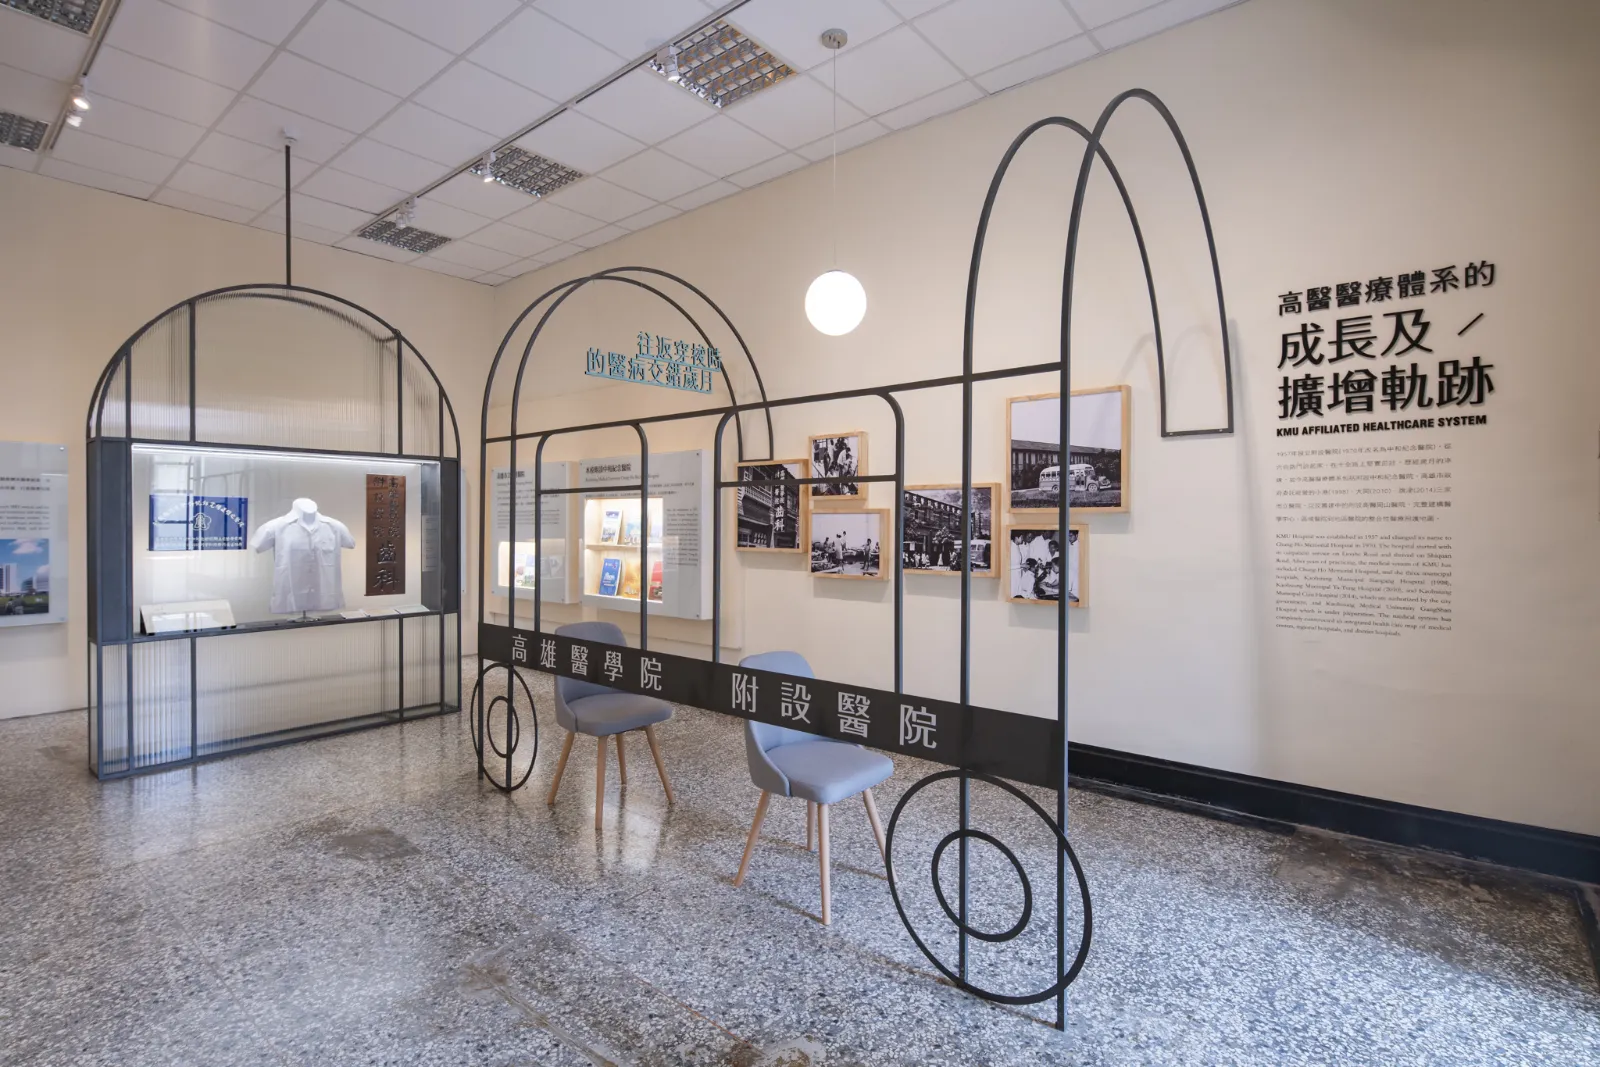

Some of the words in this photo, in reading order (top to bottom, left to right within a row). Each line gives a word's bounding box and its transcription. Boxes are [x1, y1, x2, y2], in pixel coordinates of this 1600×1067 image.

[1278, 260, 1495, 316] 高醫醫療體系的
[1277, 308, 1434, 369] 成長及
[587, 347, 712, 391] 的醫病交錯歲月
[1278, 356, 1494, 420] 擴增軌跡
[1276, 427, 1299, 437] KMU
[1302, 423, 1360, 435] AFFILIATED
[1363, 419, 1434, 432] HEALTHCARE
[1438, 415, 1487, 427] SYSTEM
[511, 634, 663, 692] 高雄醫學院
[731, 672, 938, 749] 附設醫院
